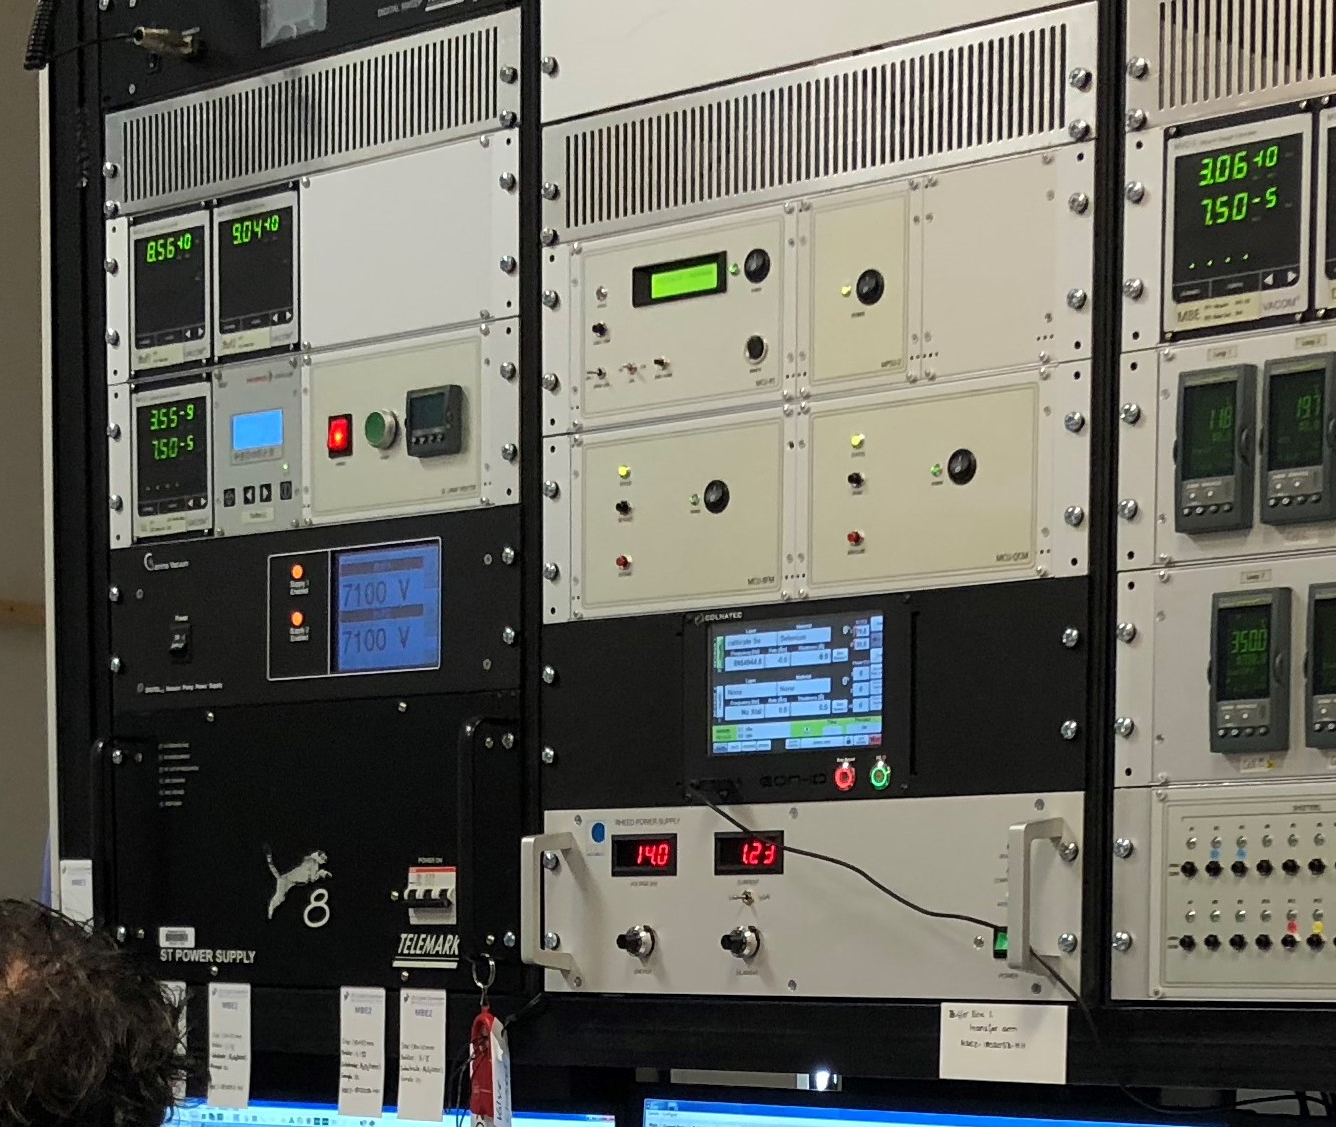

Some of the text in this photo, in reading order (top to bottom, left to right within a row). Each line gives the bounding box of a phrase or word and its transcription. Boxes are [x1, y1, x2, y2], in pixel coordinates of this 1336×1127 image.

[1176, 308, 1200, 323] MBE
[342, 578, 411, 607] 7100 V
[342, 625, 411, 655] 7100 V
[303, 888, 331, 928] 8
[160, 949, 256, 964] ST POWER SUPPLY
[397, 932, 460, 956] TELEMARK
